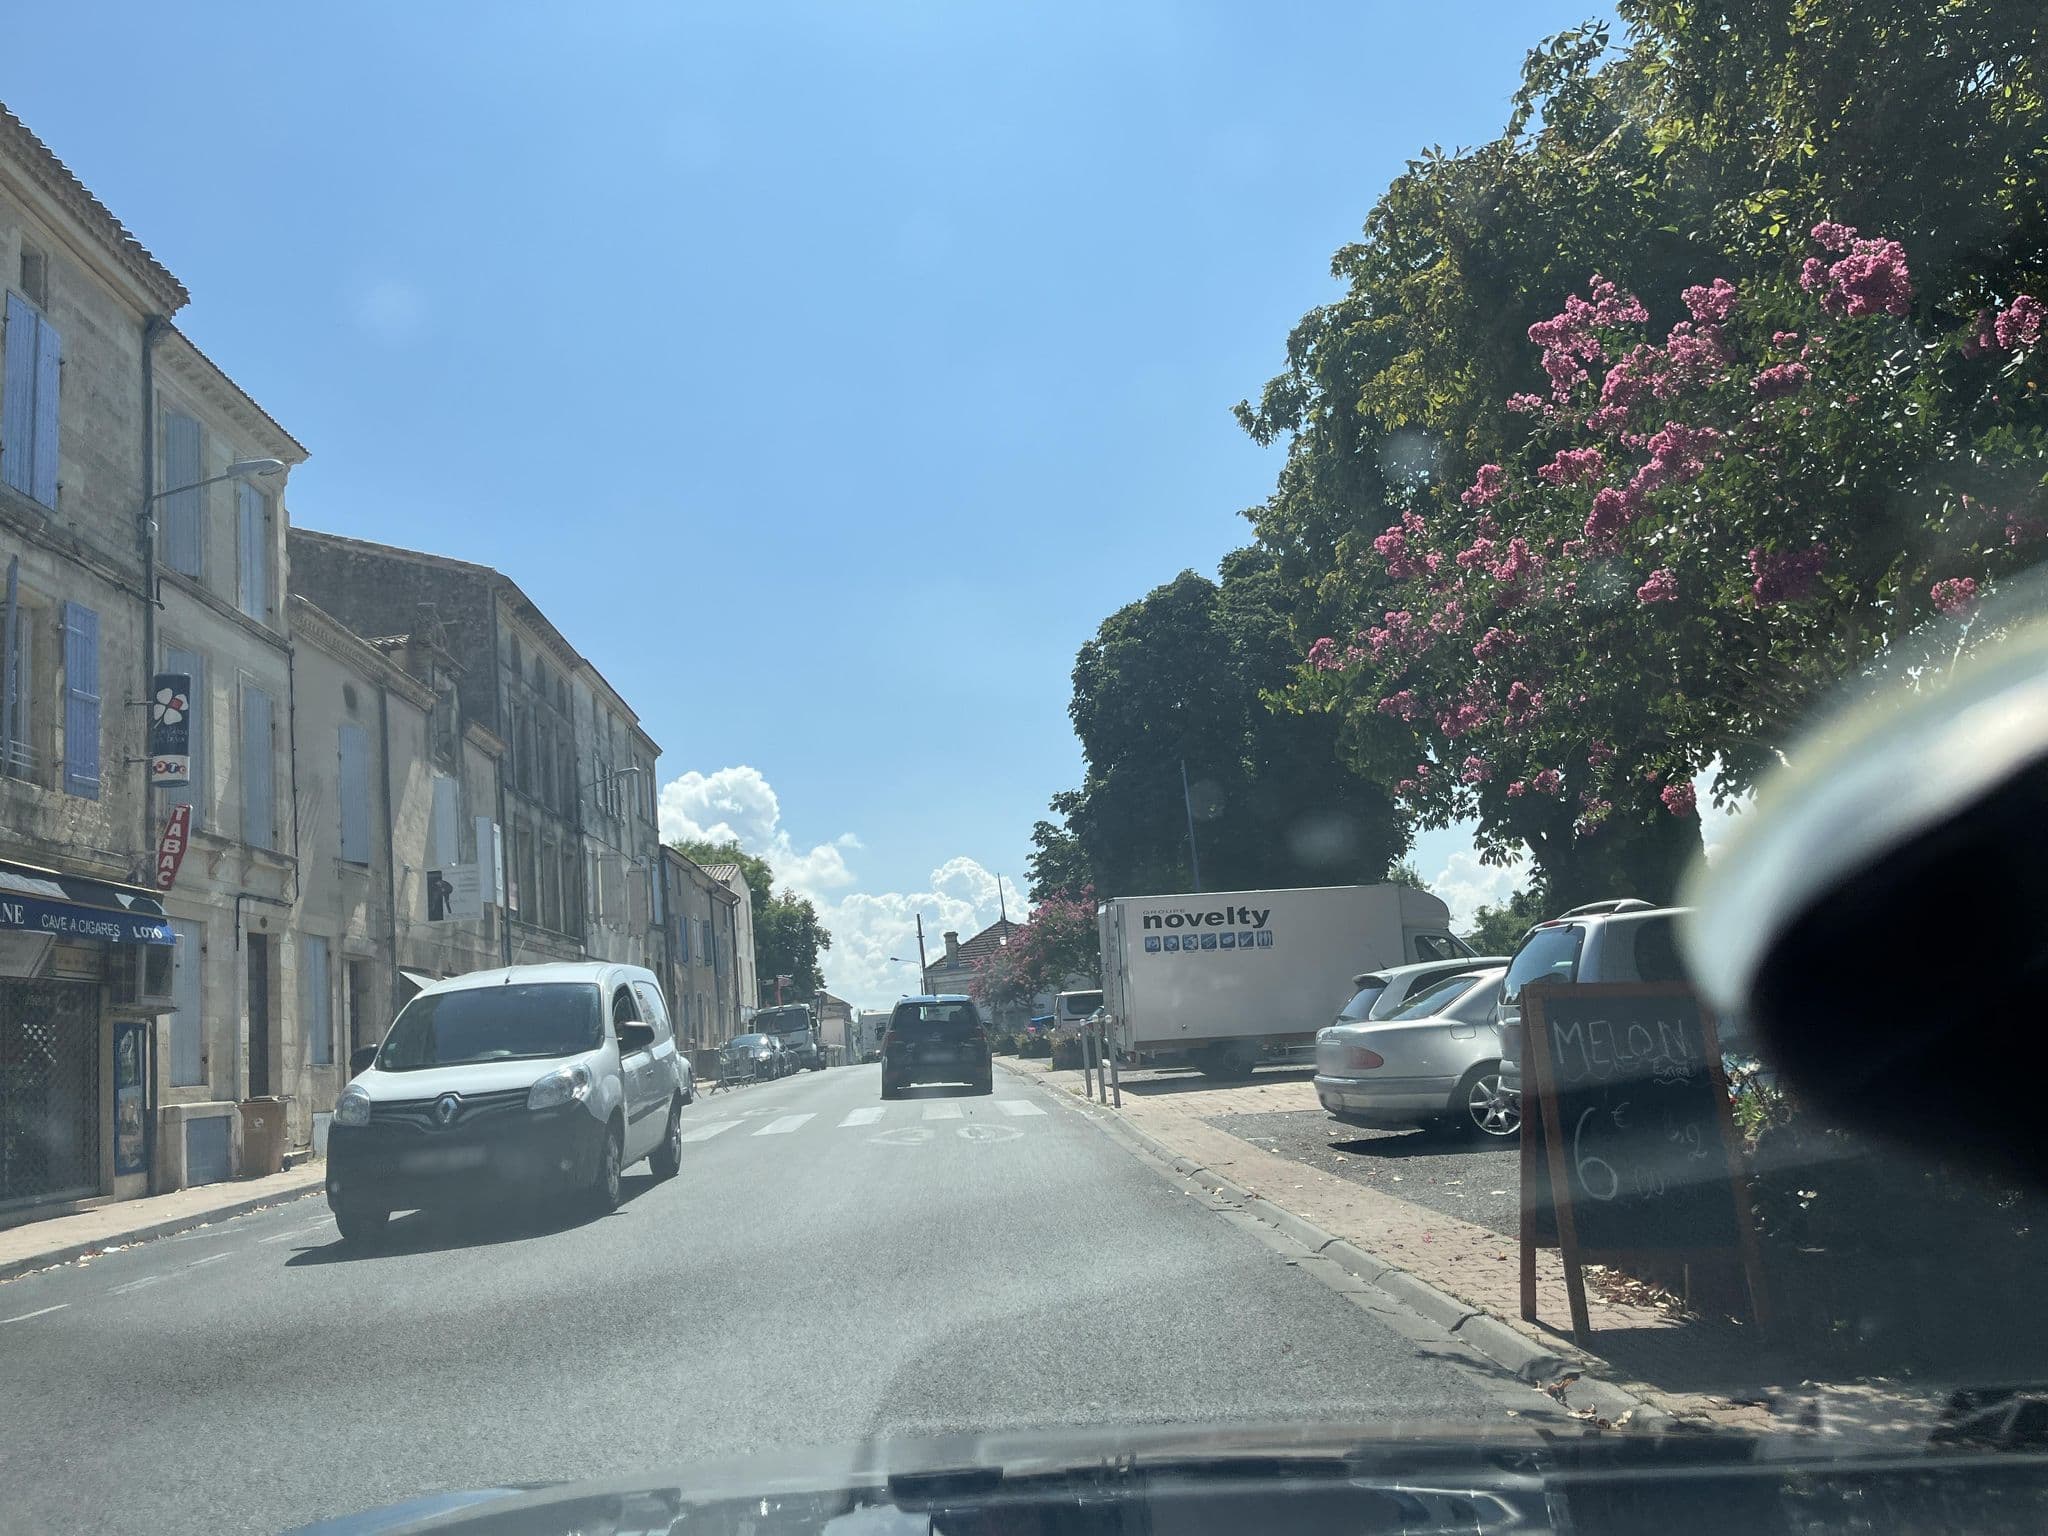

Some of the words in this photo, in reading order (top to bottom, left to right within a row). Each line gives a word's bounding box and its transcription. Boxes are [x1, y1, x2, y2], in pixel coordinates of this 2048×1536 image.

[158, 807, 187, 886] TABAC
[41, 914, 68, 931] CAVE
[78, 919, 121, 937] CIGARES
[132, 925, 164, 940] LOTO
[1143, 906, 1271, 930] novelty
[1553, 1019, 1688, 1072] MELON
[1574, 1106, 1618, 1201] 6
